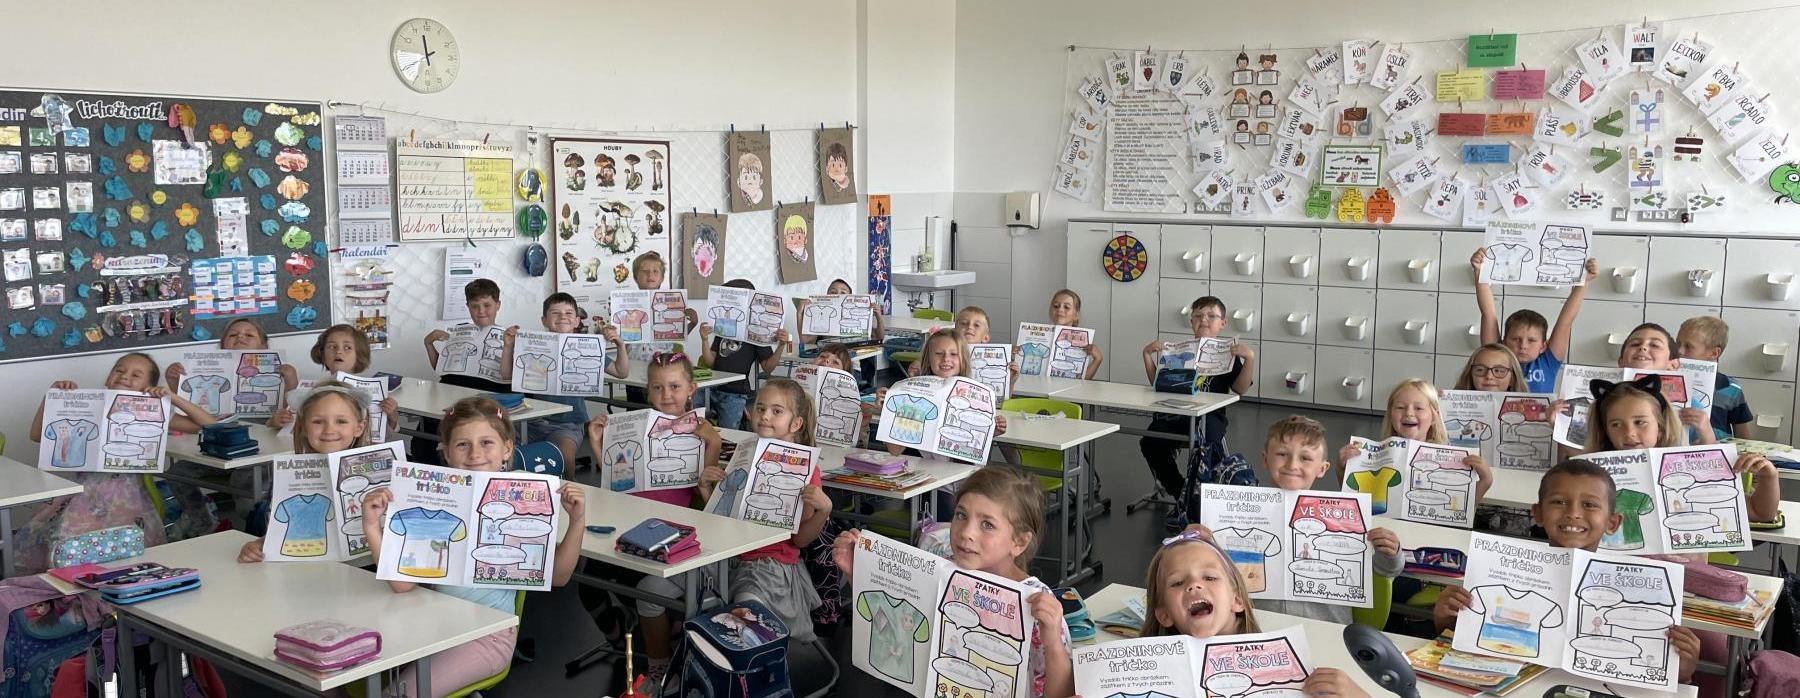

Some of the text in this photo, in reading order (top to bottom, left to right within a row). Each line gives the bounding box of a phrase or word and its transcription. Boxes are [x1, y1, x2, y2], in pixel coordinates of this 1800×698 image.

[1633, 32, 1655, 43] WALT
[1588, 44, 1609, 60] VÍLA
[1671, 41, 1706, 63] LEXIKON
[1172, 62, 1183, 71] ERB
[1311, 51, 1339, 75] NÁRAMEK
[1558, 69, 1584, 100] UBROUSEK
[1712, 68, 1736, 92] RYBKA
[1300, 84, 1313, 99] MEČ
[1735, 95, 1765, 125] ZRCADLO
[1287, 110, 1301, 137] LEKTVAR
[1279, 142, 1293, 168] KORUNA
[1237, 186, 1255, 195] PRINC
[395, 466, 472, 486] PRÁZDNINOVÉ
[1300, 506, 1315, 516] VE
[859, 537, 936, 576] PRÁZDNINOVÉ
[1474, 537, 1570, 565] PRÁZDNINOVÉ
[1500, 556, 1543, 574] tričko
[975, 582, 1000, 595] ZPÁTKY
[1590, 572, 1663, 590] VE ŠKOLE
[952, 585, 1016, 620] VE ŠKOLE
[1078, 641, 1185, 664] PRÁZDNINOVÉ
[1235, 644, 1264, 652] ZPÁTKY
[1109, 658, 1157, 672] tričko
[1210, 652, 1290, 671] VE ŠKOLE
